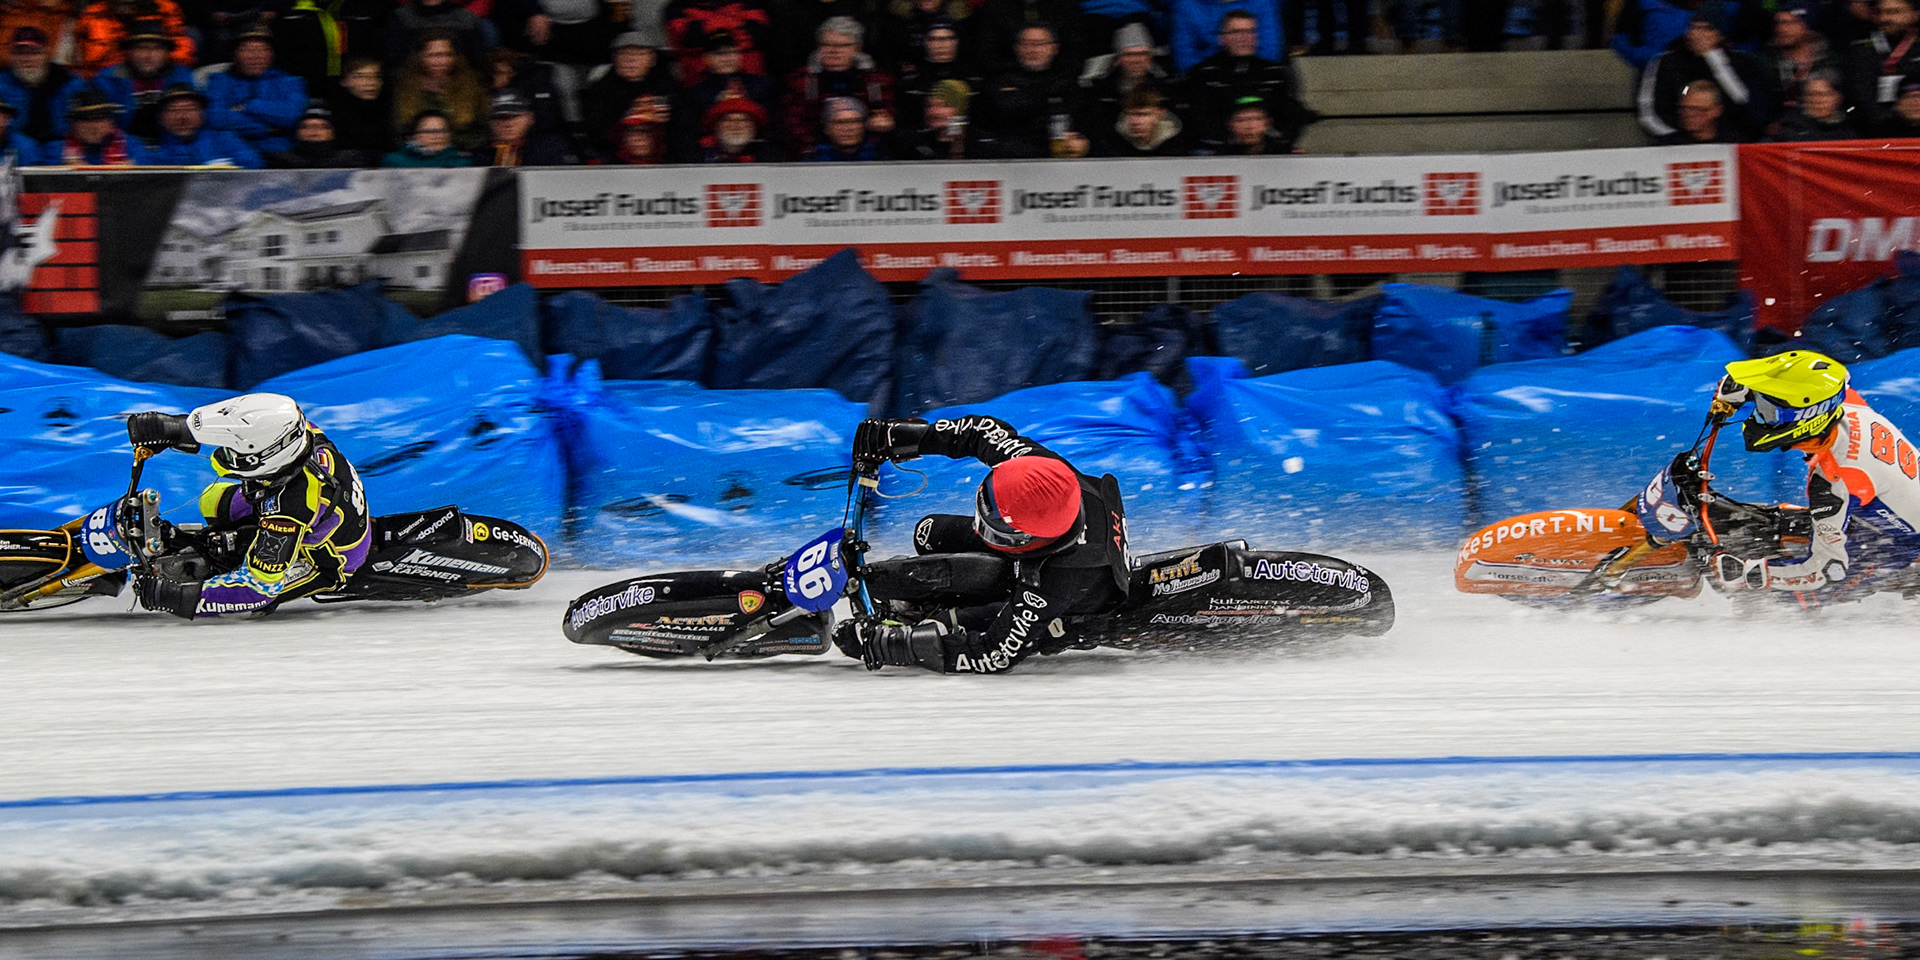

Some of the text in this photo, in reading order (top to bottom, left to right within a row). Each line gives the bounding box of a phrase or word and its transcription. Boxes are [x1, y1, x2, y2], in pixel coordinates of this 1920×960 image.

[1793, 413, 1828, 438] NOLAN
[1846, 411, 1862, 460] IWEMA
[1871, 421, 1920, 480] 80
[80, 528, 88, 545] FIM
[89, 507, 117, 555] 88
[390, 567, 461, 581] KAPSNER
[785, 569, 799, 594] FIM
[798, 540, 833, 599] 66
[1253, 559, 1370, 593] Autotarvike
